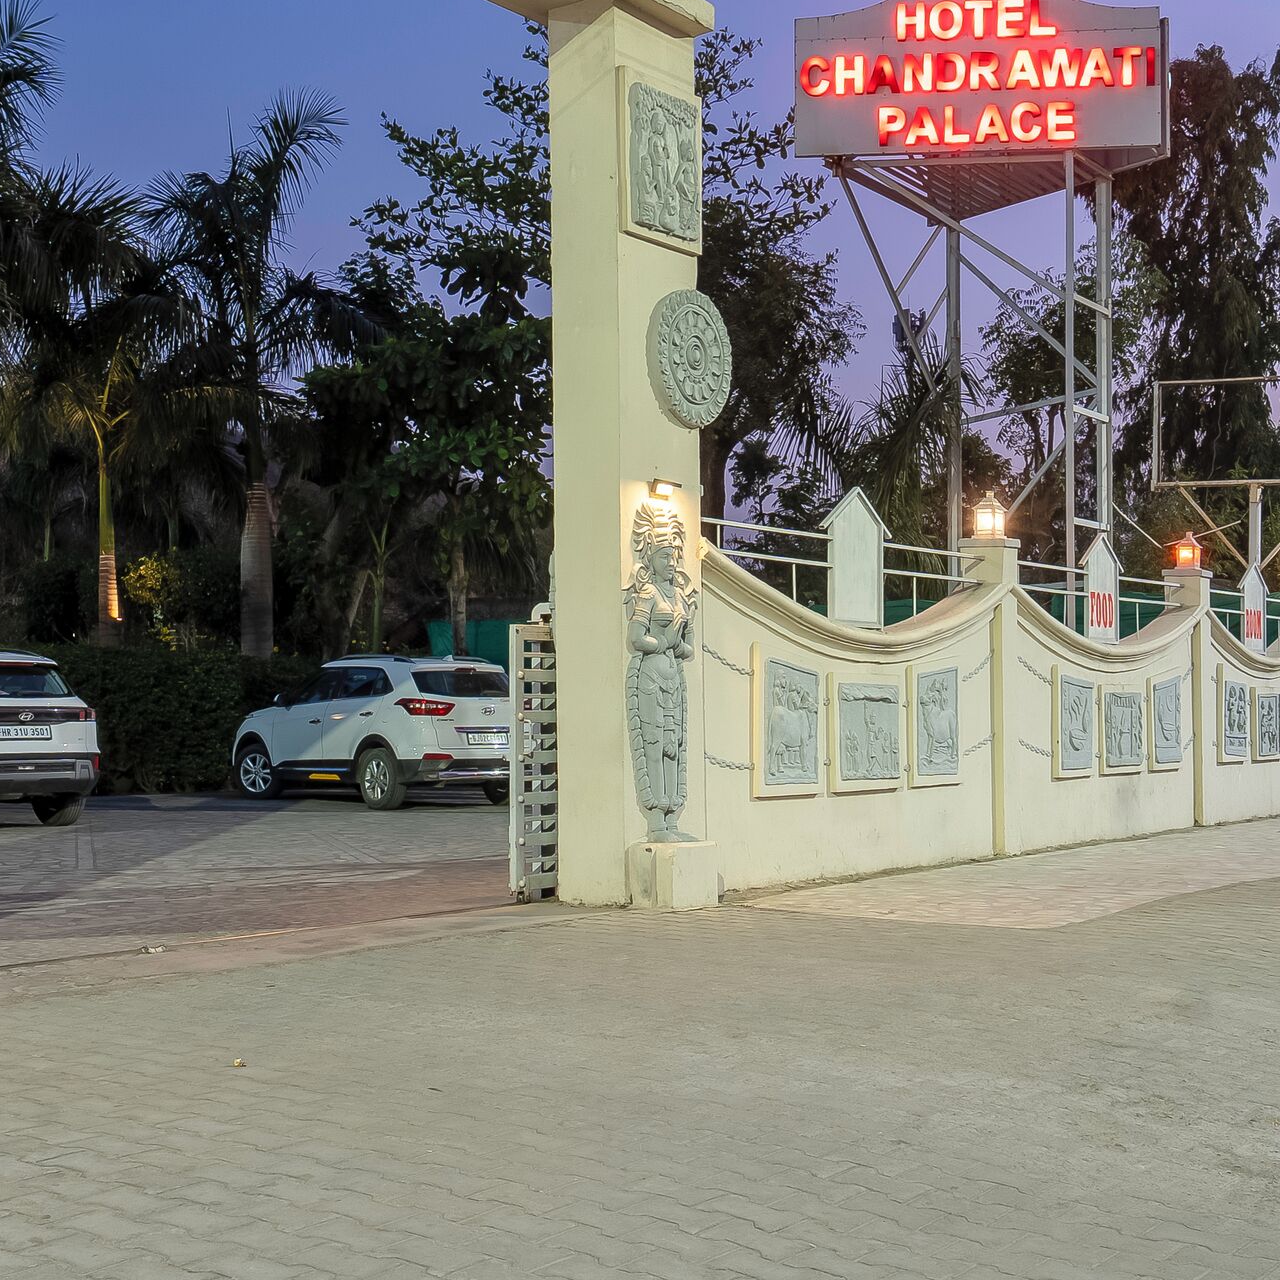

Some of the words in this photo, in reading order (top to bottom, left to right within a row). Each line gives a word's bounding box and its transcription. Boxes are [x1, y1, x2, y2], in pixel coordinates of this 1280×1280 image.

[800, 47, 1156, 96] CHANDRAWATI
[878, 101, 1076, 146] PALACE
[1090, 591, 1114, 628] FOOD
[1246, 609, 1262, 639] ROOM
